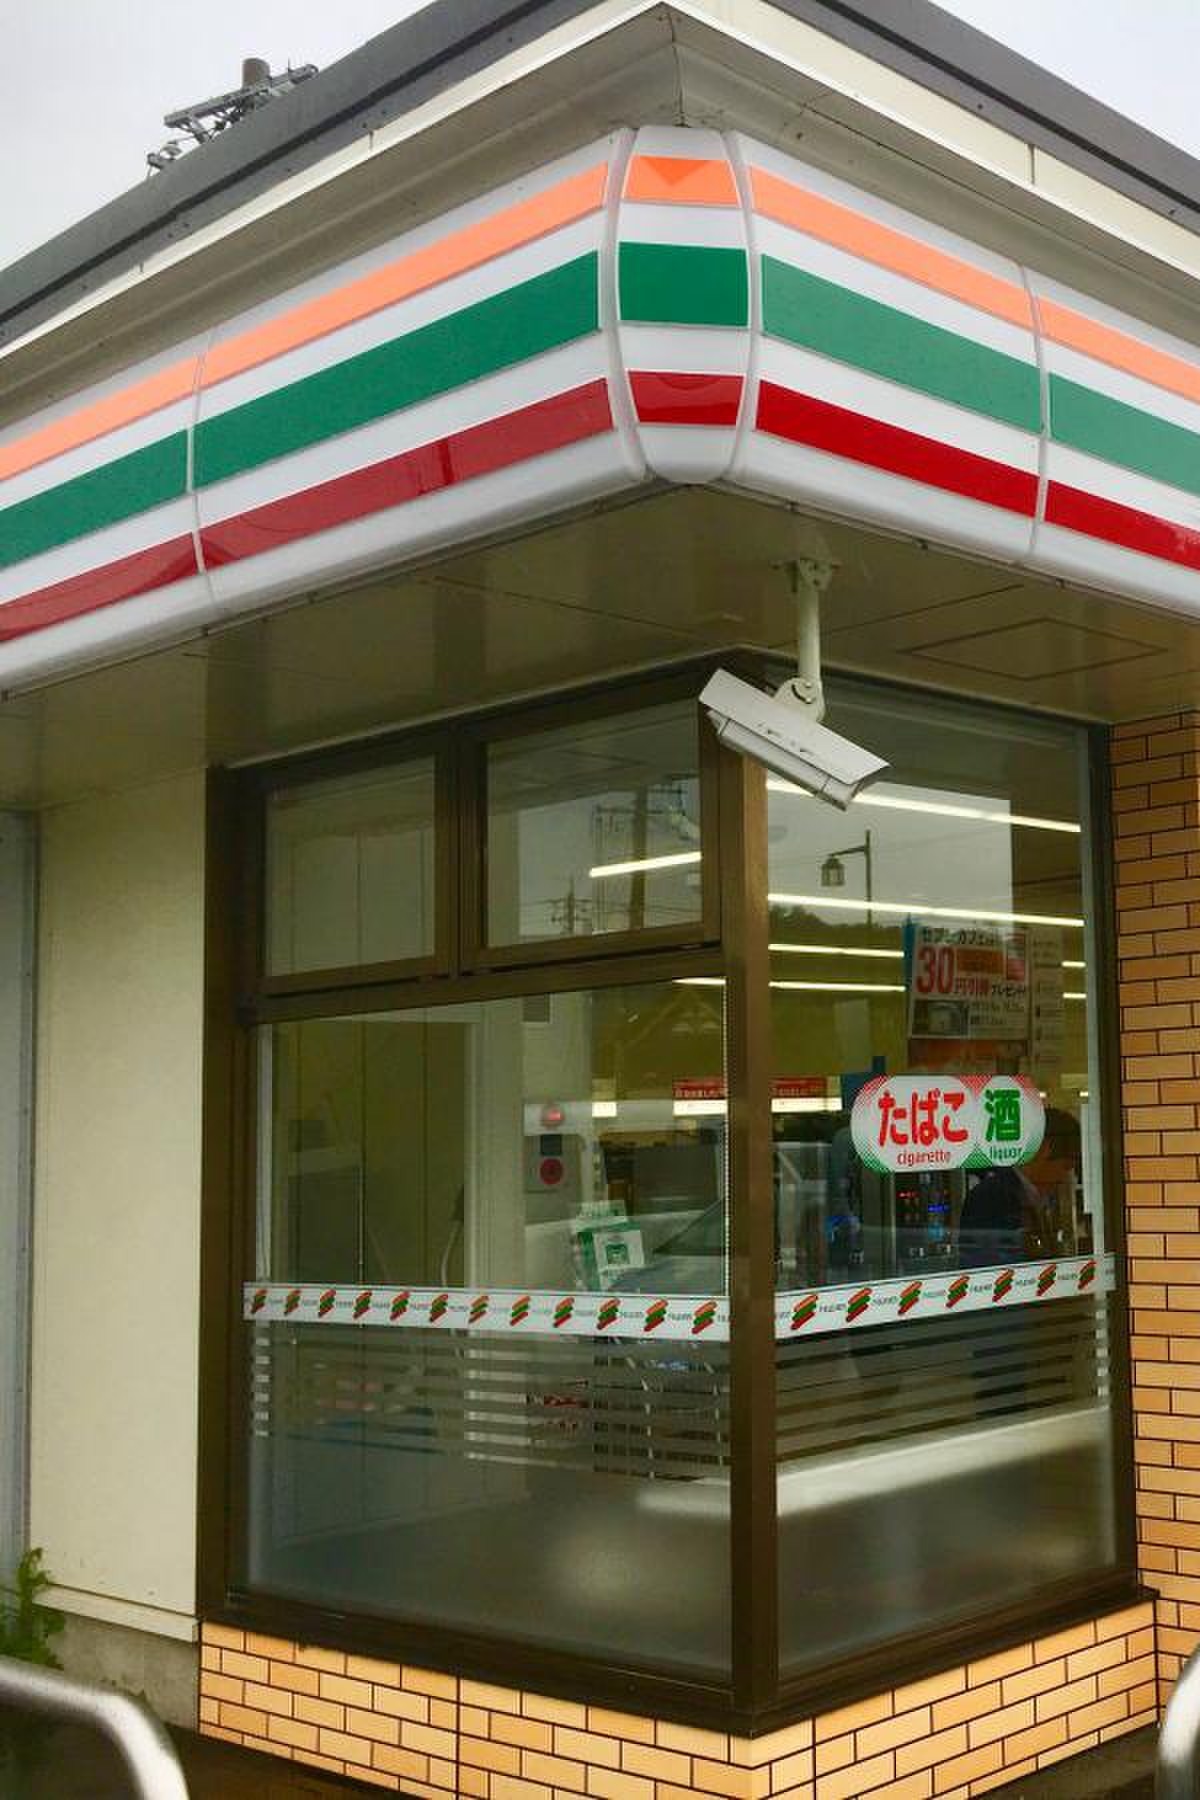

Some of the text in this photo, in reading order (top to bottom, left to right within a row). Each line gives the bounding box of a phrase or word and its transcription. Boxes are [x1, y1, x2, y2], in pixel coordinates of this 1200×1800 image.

[916, 946, 955, 993] 30
[876, 1088, 1022, 1148] たばこ 酒
[896, 1145, 1024, 1167] cigarette liquor
